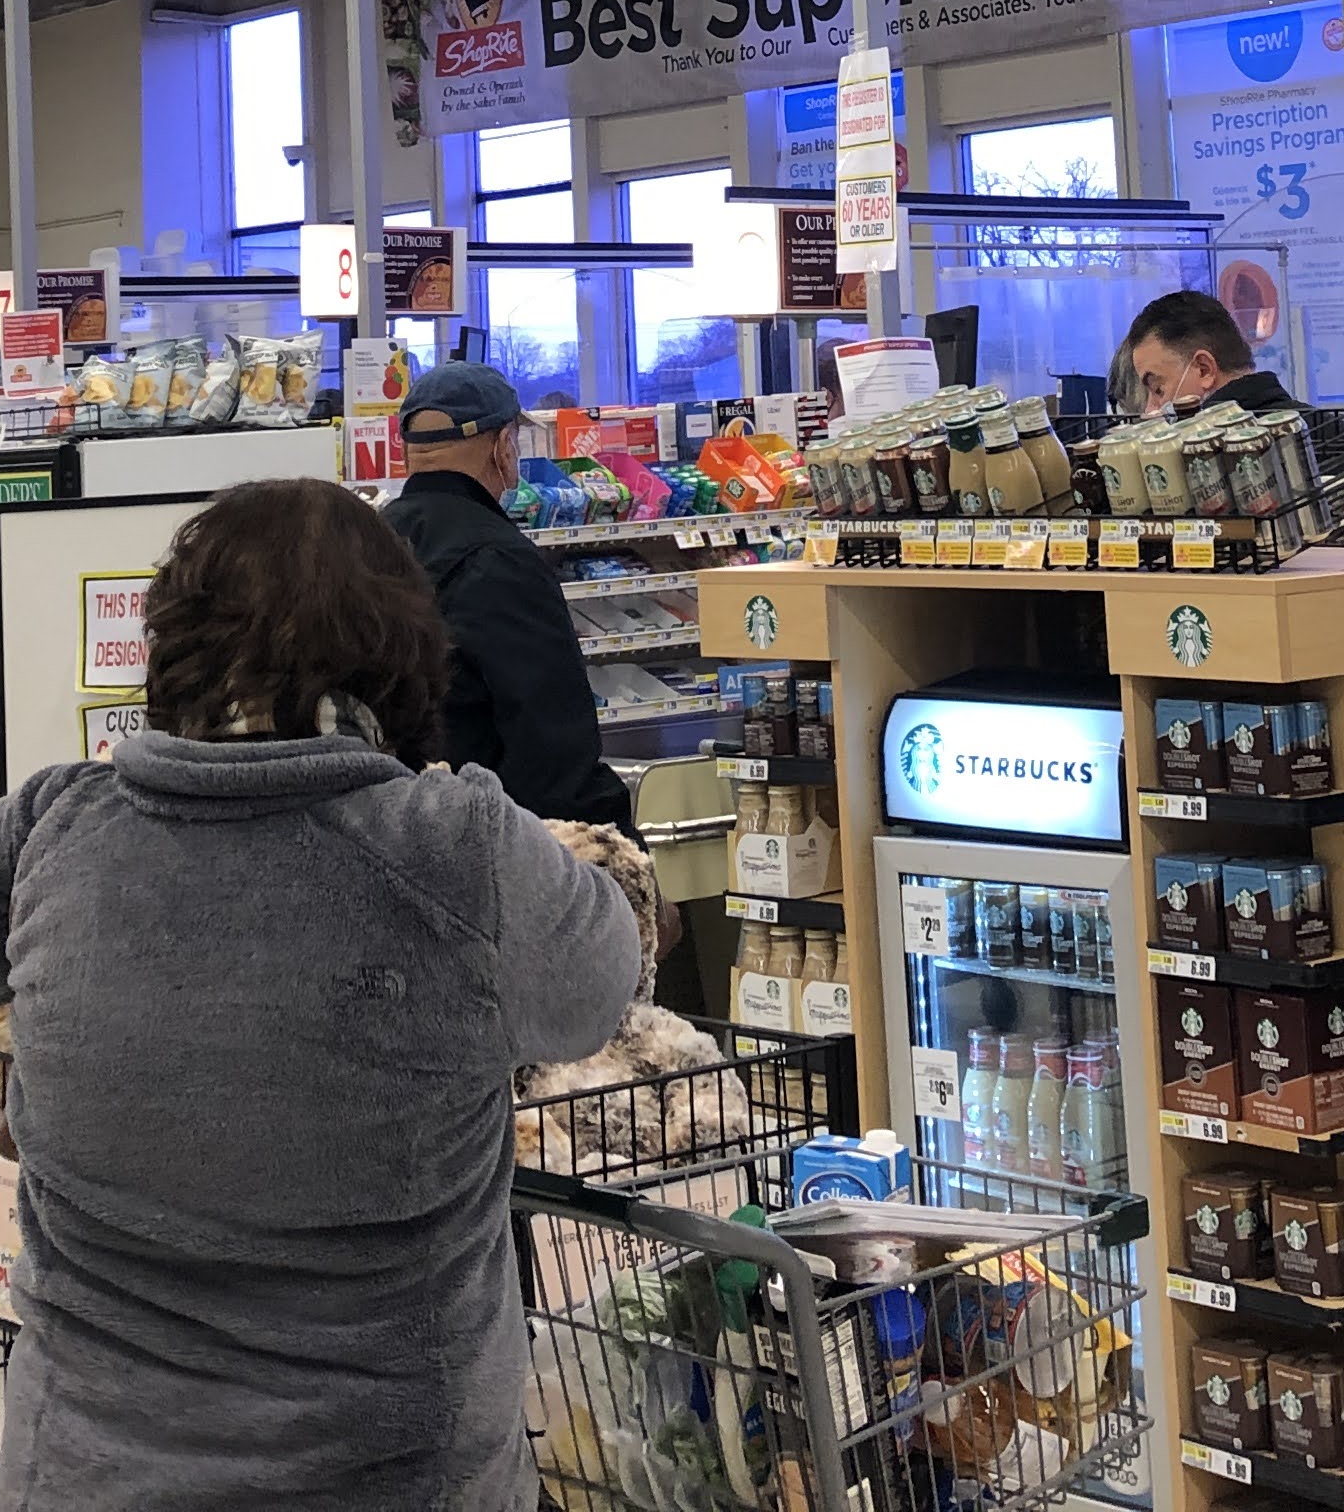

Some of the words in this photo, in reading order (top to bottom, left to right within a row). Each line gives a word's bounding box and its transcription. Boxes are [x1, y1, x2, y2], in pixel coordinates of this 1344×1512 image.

[662, 49, 703, 73] Thank
[705, 47, 735, 65] You
[740, 44, 756, 61] to
[761, 38, 792, 57] Our
[919, 10, 931, 29] &
[1239, 25, 1290, 55] new!
[441, 28, 520, 78] ShopRite
[805, 94, 836, 110] ShopR
[1212, 102, 1328, 132] Prescription
[791, 140, 812, 156] Ban
[815, 137, 834, 152] the
[1193, 133, 1266, 160] Savings
[789, 163, 814, 178] Get
[846, 180, 887, 195] CUSTOMERS
[842, 201, 854, 223] 60
[856, 196, 891, 222] YEARS
[795, 214, 824, 231] OUR
[850, 224, 860, 237] OR
[862, 222, 885, 236] OLDER
[383, 234, 403, 248] OUR
[404, 234, 443, 248] PROMISE
[37, 276, 57, 288] OUR
[58, 275, 94, 287] PROMISE
[338, 248, 353, 299] 8
[724, 405, 754, 417] REGAL
[354, 427, 385, 438] NETFLIX
[840, 520, 902, 533] TARBUCKS
[95, 593, 126, 619] THIS
[94, 641, 147, 667] DESIGN
[955, 754, 1094, 785] STARBUCKS
[1182, 801, 1202, 817] 6.99
[1190, 961, 1211, 977] 6.99
[1202, 1123, 1223, 1140] 6.99
